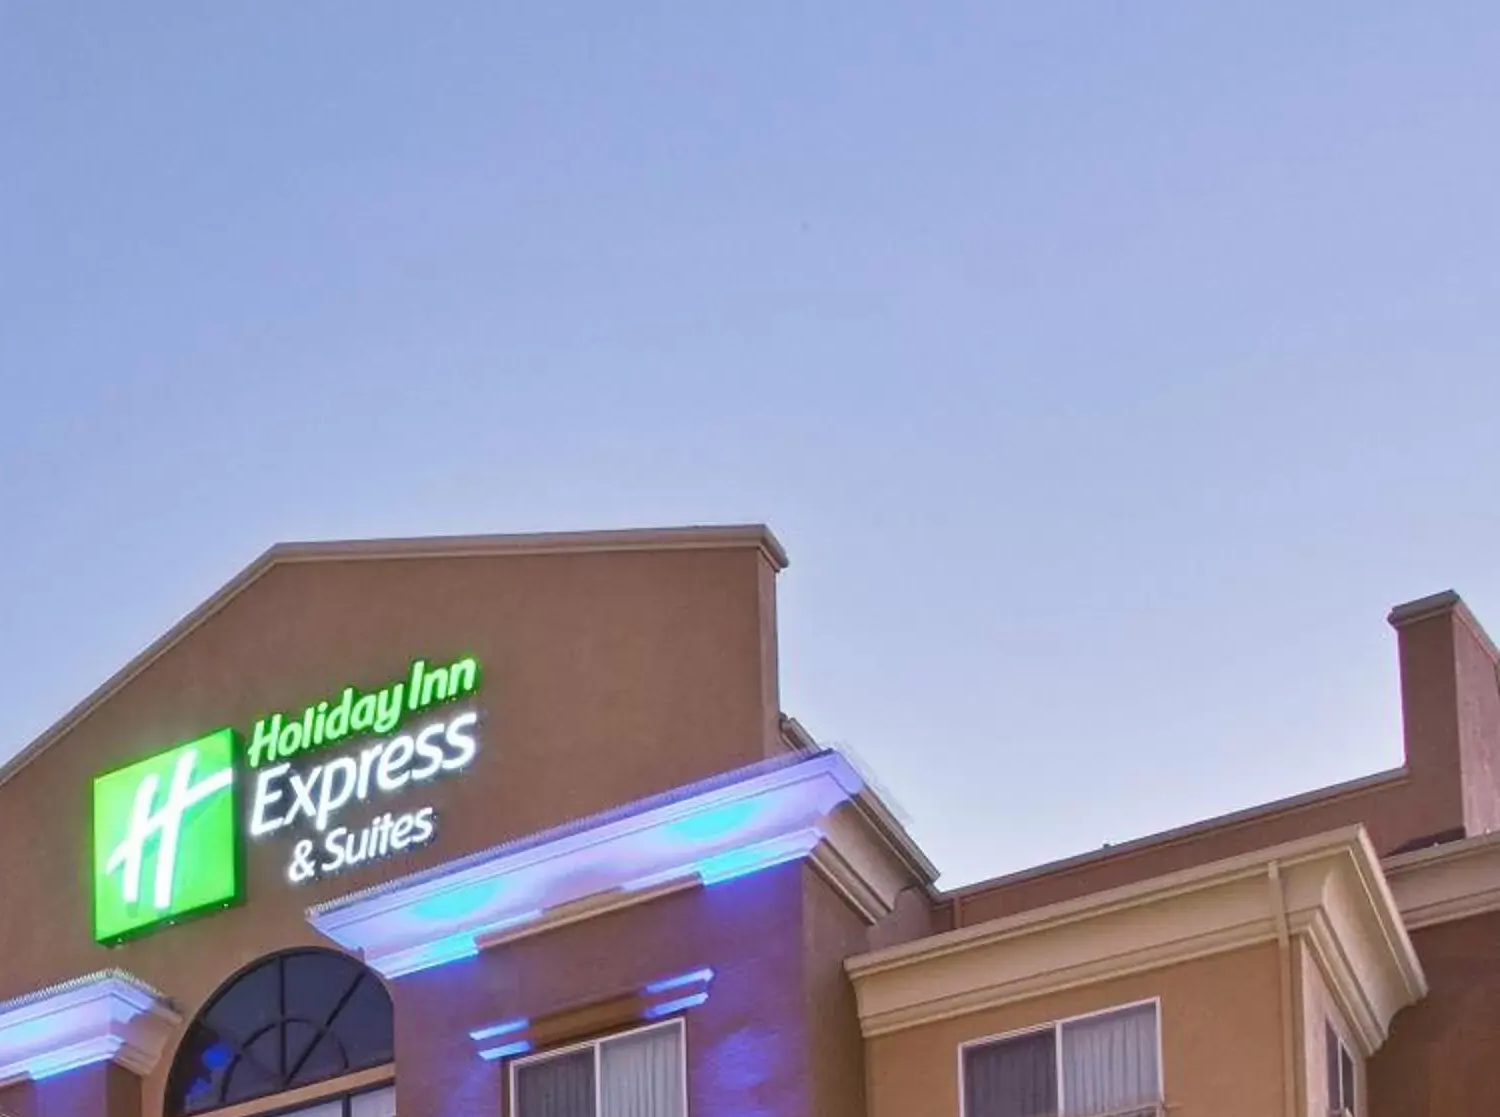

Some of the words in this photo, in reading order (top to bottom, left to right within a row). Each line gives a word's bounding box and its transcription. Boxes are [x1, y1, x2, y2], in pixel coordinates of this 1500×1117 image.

[247, 683, 404, 768] Holiday
[408, 658, 476, 710] Inn
[106, 747, 233, 910] H
[250, 711, 478, 836] Express
[287, 839, 316, 882] &
[321, 807, 433, 872] Suites
